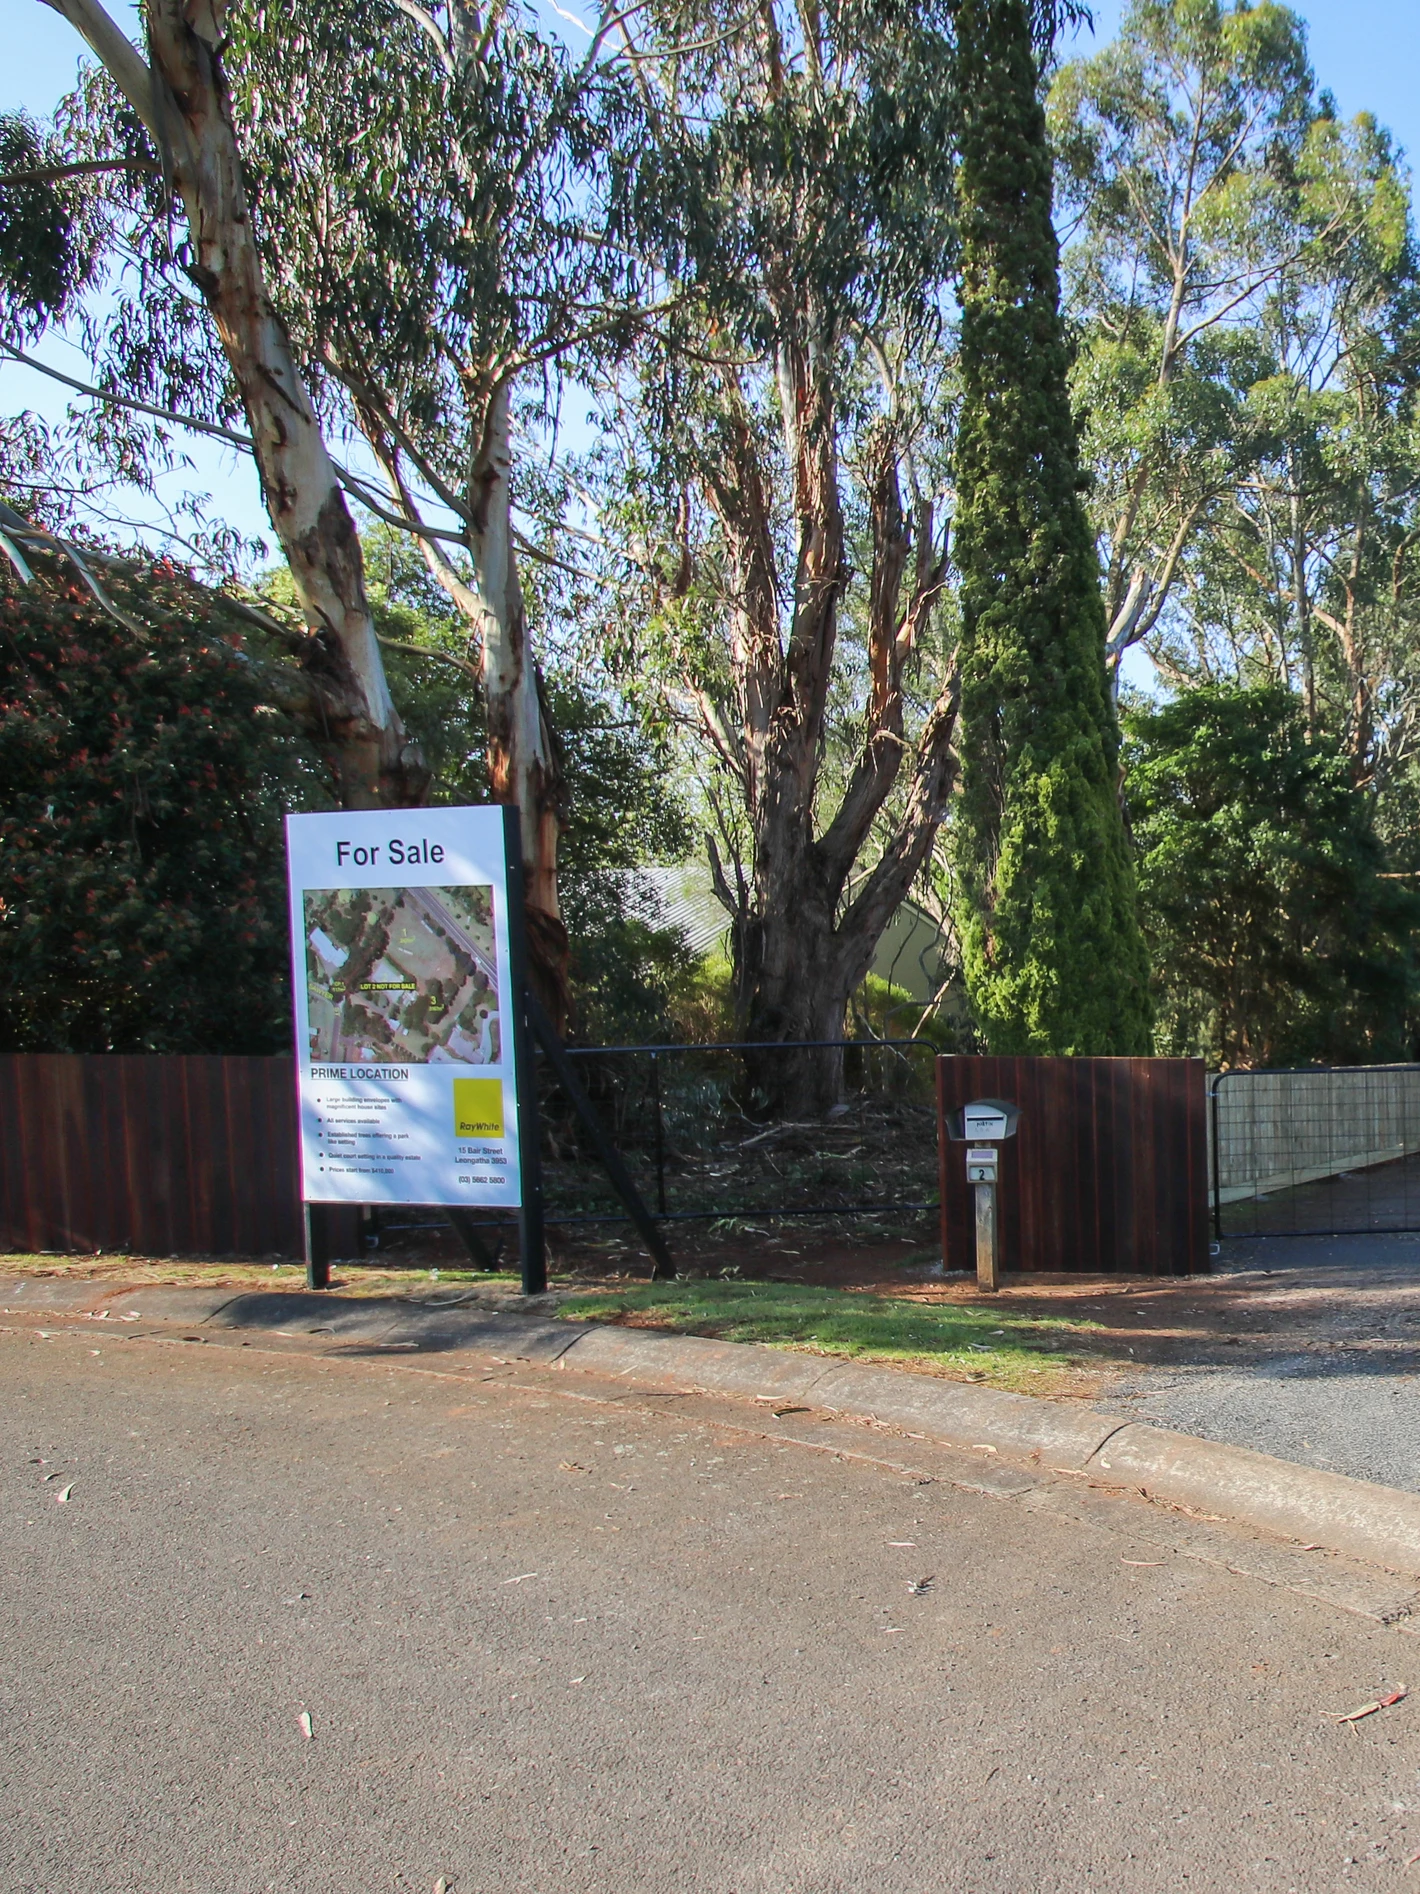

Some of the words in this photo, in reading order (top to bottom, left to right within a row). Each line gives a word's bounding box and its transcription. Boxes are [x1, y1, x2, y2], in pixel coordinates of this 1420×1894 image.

[336, 840, 380, 866] For
[388, 838, 445, 865] Sale
[430, 996, 436, 1005] 3
[311, 1068, 347, 1079] PRIME
[350, 1068, 409, 1080] LOCATION
[460, 1122, 500, 1132] RayWhite
[455, 1157, 490, 1165] Leongatha
[978, 1169, 985, 1180] 2
[458, 1176, 471, 1184] (03)
